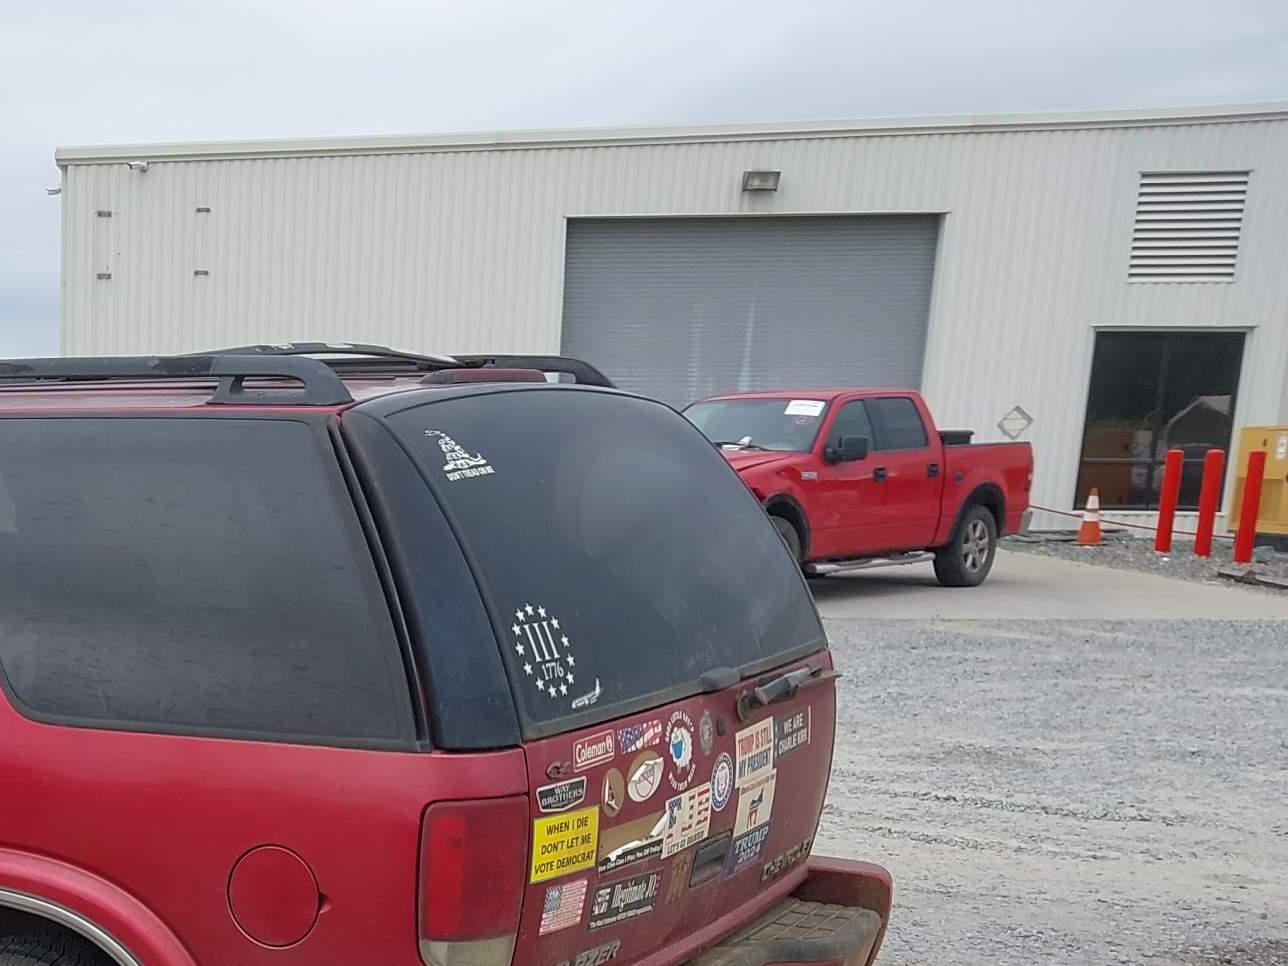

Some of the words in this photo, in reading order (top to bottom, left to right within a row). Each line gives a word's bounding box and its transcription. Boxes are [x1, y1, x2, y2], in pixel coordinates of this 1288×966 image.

[542, 661, 564, 680] 1776
[783, 718, 792, 735] WE
[792, 712, 804, 731] ARE
[575, 740, 606, 764] Coleman
[737, 733, 755, 759] TRUMP
[760, 724, 772, 748] STILL
[747, 747, 772, 777] PRESIDENT
[541, 788, 584, 807] BROTHERS
[554, 784, 570, 795] WAY
[546, 821, 570, 836] WHEN
[571, 820, 575, 830] I
[576, 816, 589, 829] DIE
[541, 840, 564, 855] DON'T
[566, 836, 580, 849] LET
[580, 833, 591, 846] ME
[734, 825, 769, 855] TRUMP
[534, 859, 555, 875] VOTE
[556, 850, 595, 869] DEMOCRAT
[737, 843, 761, 864] 2024
